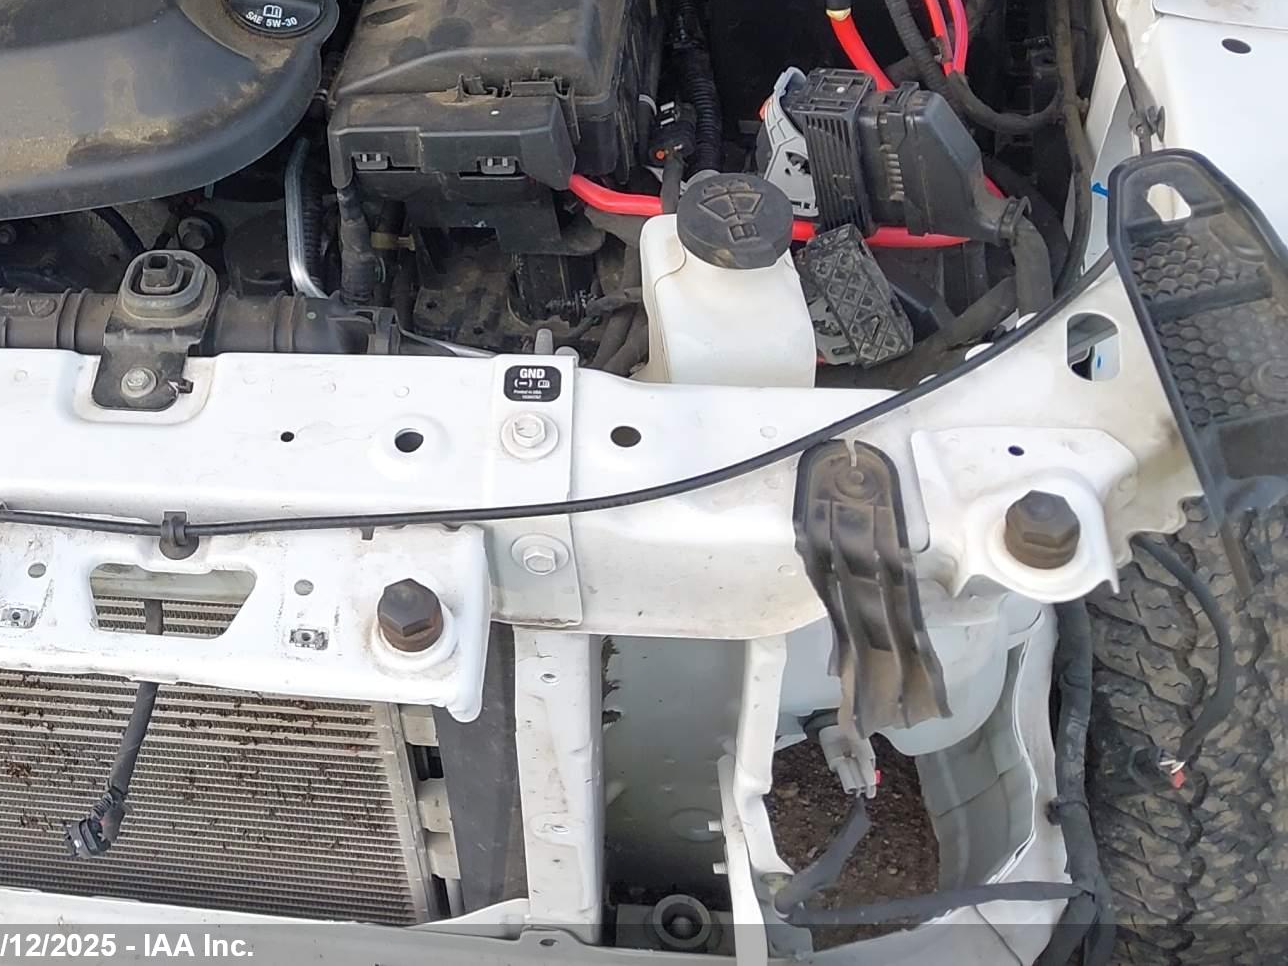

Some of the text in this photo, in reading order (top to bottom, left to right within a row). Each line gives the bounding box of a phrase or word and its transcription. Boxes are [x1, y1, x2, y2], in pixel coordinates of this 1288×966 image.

[245, 11, 298, 28] SAE 5W-30
[519, 368, 546, 379] GND
